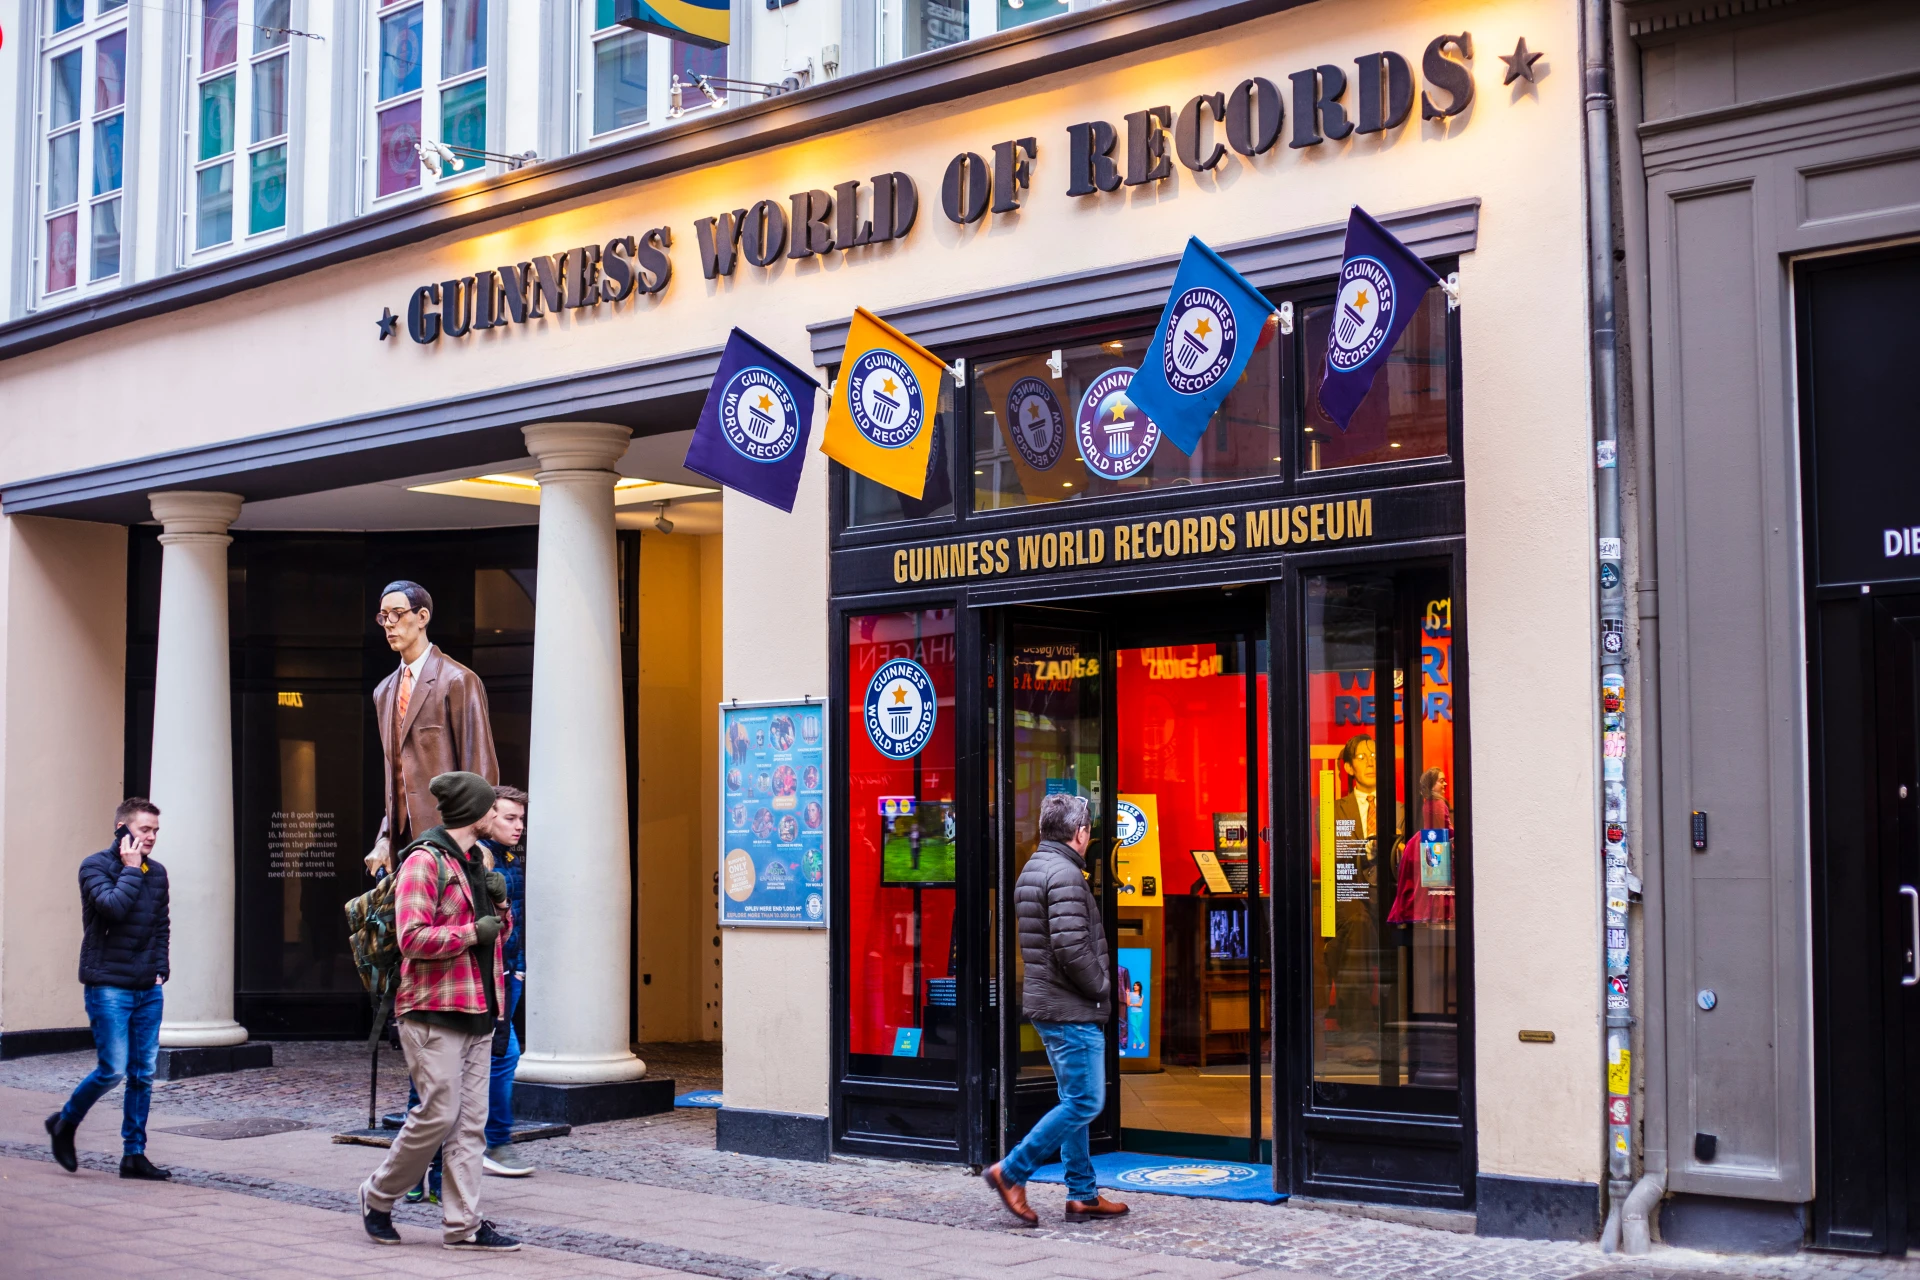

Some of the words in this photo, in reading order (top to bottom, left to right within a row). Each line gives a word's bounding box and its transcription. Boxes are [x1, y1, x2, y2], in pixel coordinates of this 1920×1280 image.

[408, 226, 672, 344] GUINNESS
[694, 171, 919, 280] WORLD
[941, 136, 1037, 224] OF
[1066, 31, 1474, 198] RECORDS
[1345, 263, 1391, 312] GUINNESS
[1184, 292, 1234, 341] GUINNESS
[1165, 314, 1179, 373] WORLD
[1332, 326, 1383, 365] RECORDS
[865, 356, 918, 396] GUINNESS
[1088, 374, 1134, 408] GUINN
[1171, 355, 1228, 390] RECORDS
[741, 372, 793, 413] GUINNESS
[851, 376, 870, 429] WORLD
[872, 408, 920, 442] RECORDS
[724, 393, 744, 444] WORLD
[746, 424, 795, 457] RECORDS
[1081, 420, 1110, 470] WORLD
[1114, 416, 1157, 473] RECORD
[893, 538, 1010, 584] GUINNESS
[1018, 528, 1105, 571] WORLD
[1115, 512, 1236, 562] RECORDS
[1246, 498, 1373, 549] MUSEUM
[874, 665, 926, 692] GUINNESS
[868, 704, 892, 750] WORLD
[895, 701, 932, 754] RECORDS
[271, 811, 289, 819] After
[290, 811, 295, 819] 8
[296, 811, 314, 820] good
[315, 812, 335, 820] years
[271, 821, 287, 829] here
[1117, 803, 1140, 817] NESS
[268, 841, 290, 849] grown
[305, 841, 338, 849] premises
[278, 830, 307, 838] Moncler
[1121, 821, 1145, 846] ECORDS
[268, 870, 285, 878] need
[286, 870, 294, 878] of
[270, 860, 290, 868] down
[729, 862, 747, 874] ONLY
